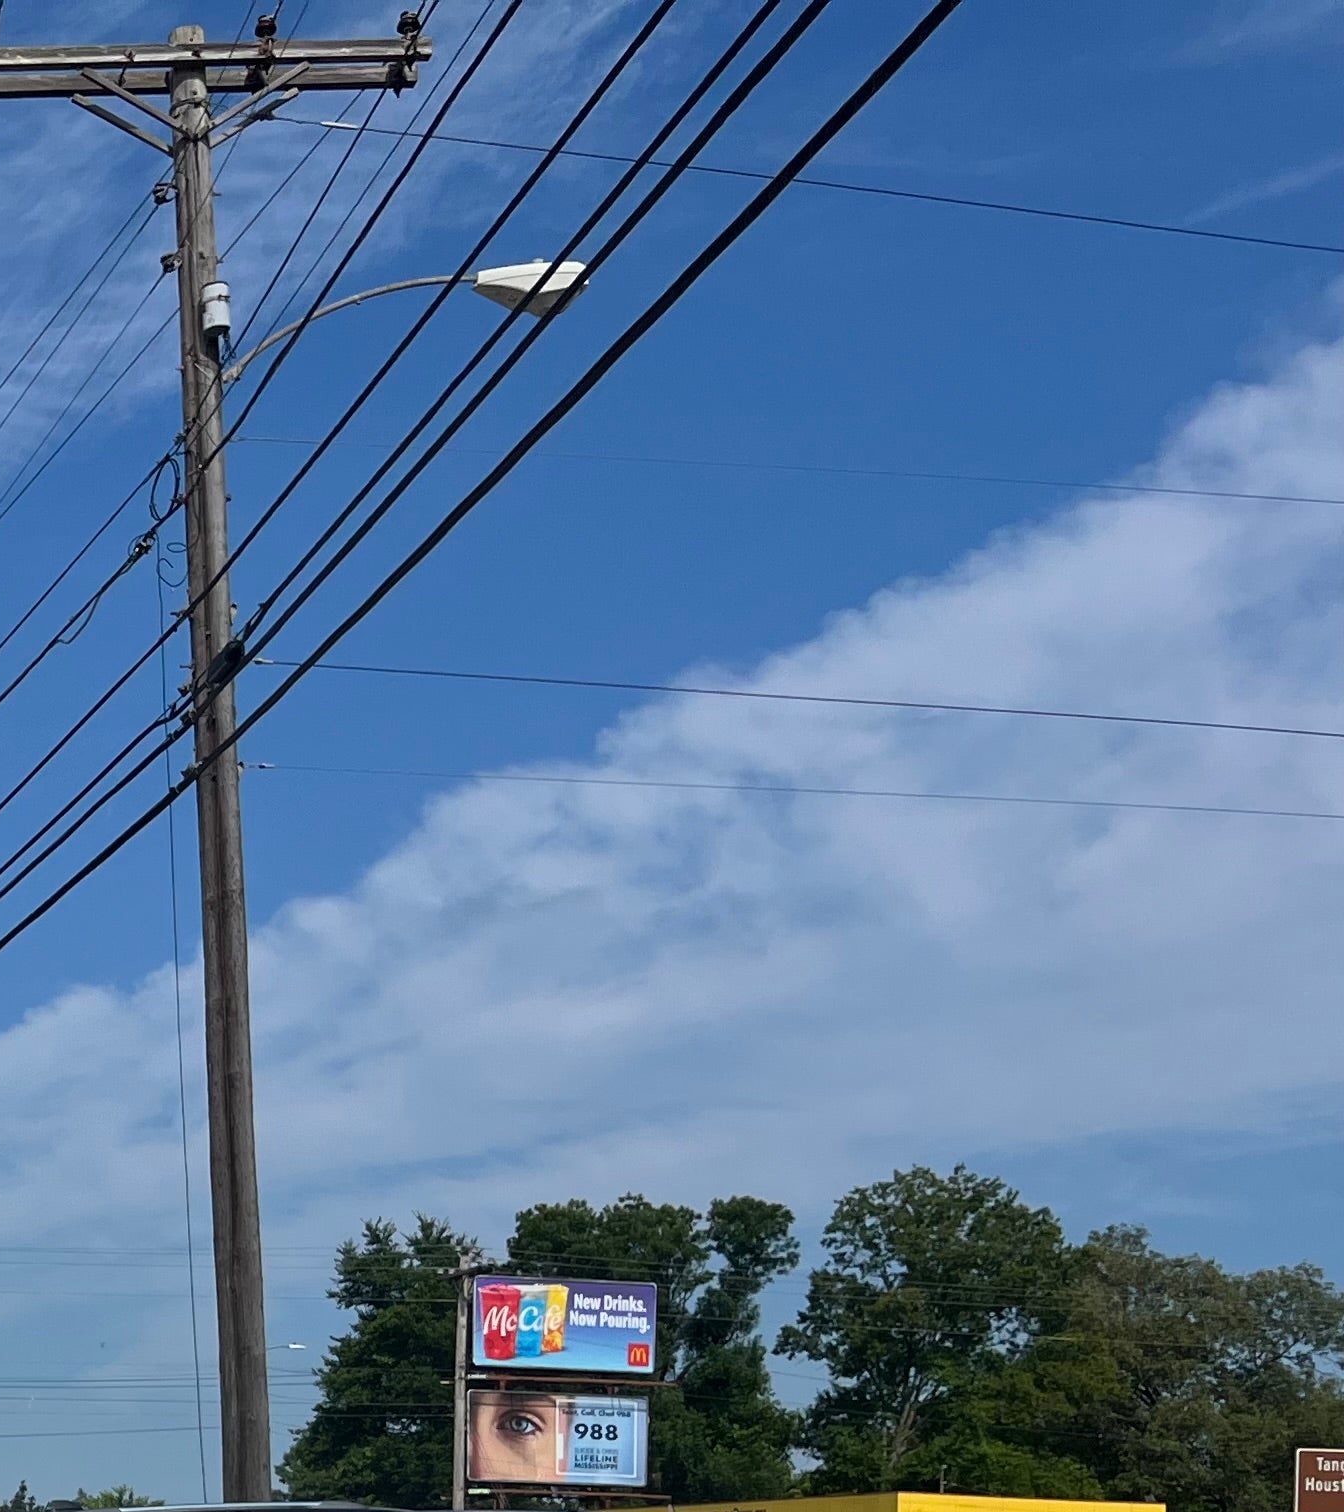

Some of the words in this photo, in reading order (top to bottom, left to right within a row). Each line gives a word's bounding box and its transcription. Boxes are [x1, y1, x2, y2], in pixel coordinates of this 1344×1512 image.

[573, 1293, 601, 1310] New
[603, 1295, 647, 1313] Drinks.
[569, 1310, 597, 1328] Now
[599, 1312, 651, 1335] Pouring.
[574, 1423, 618, 1441] 988
[574, 1454, 618, 1464] LIFELINE
